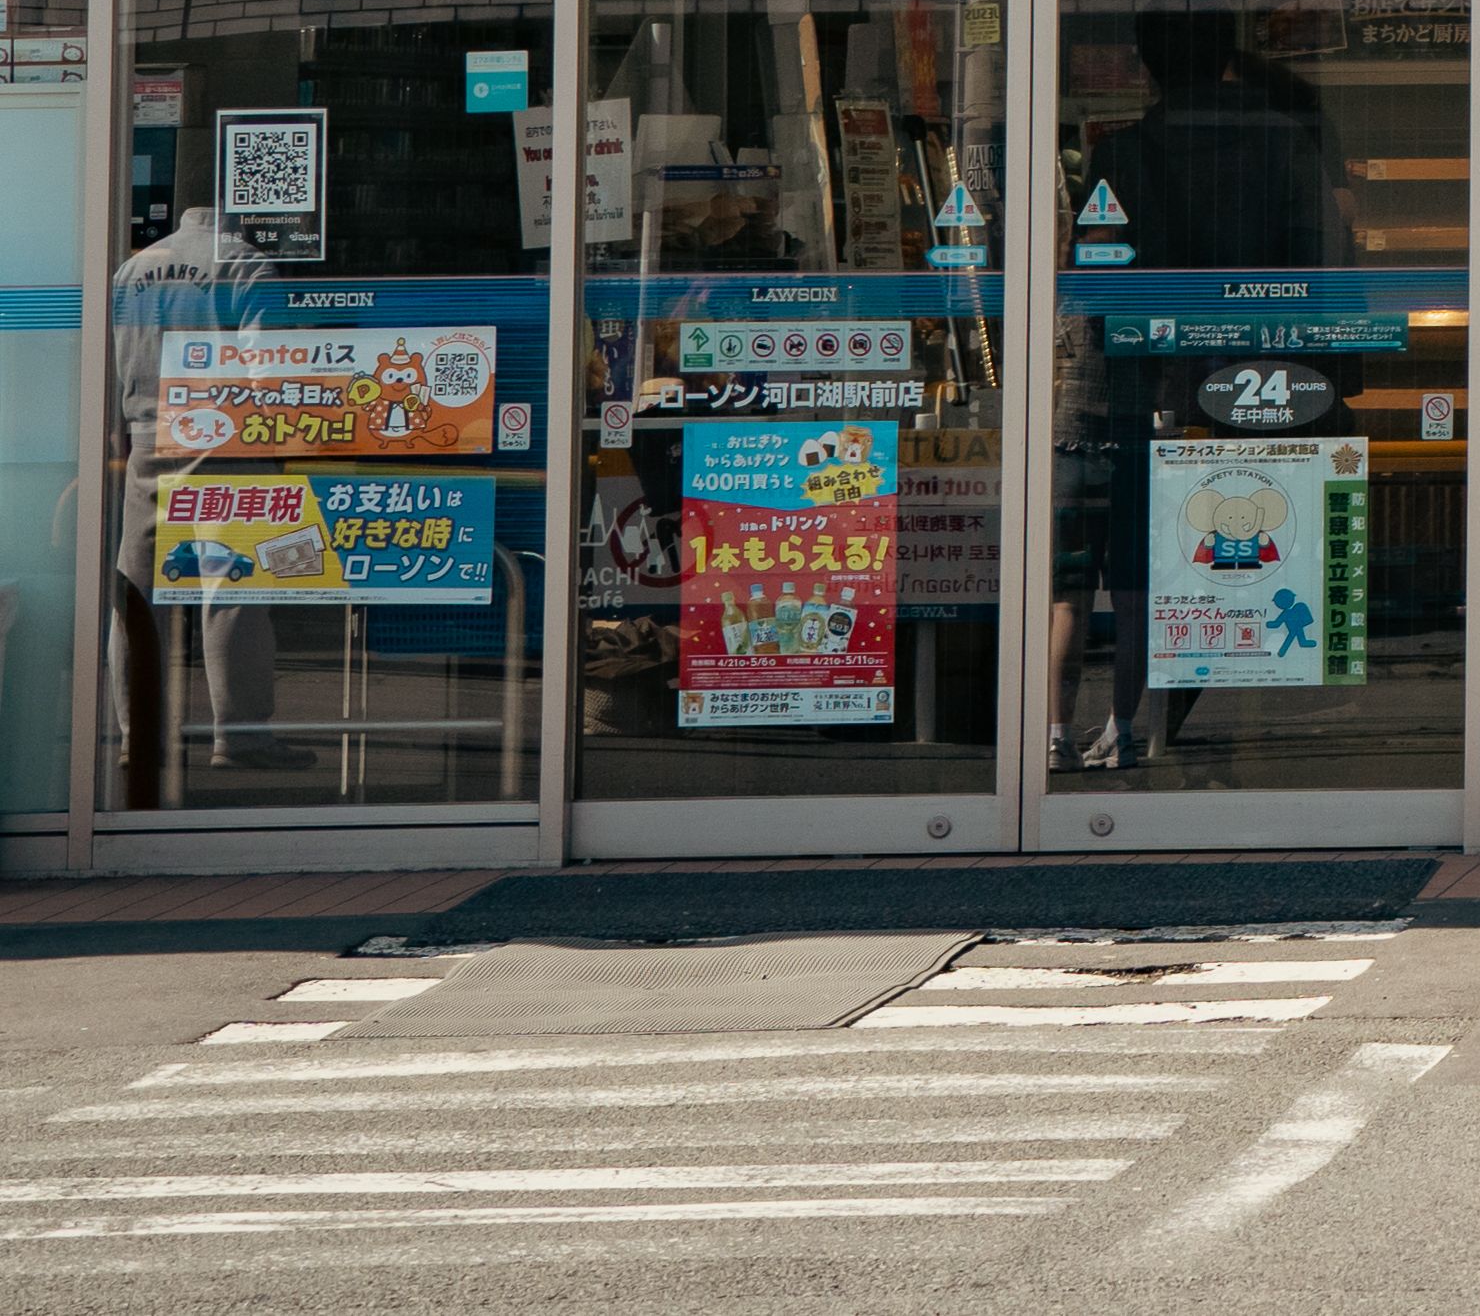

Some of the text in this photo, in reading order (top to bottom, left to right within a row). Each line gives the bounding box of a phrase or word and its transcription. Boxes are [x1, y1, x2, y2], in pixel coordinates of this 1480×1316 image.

[595, 138, 624, 155] drink
[240, 215, 301, 226] Information
[255, 231, 278, 243] 정보
[751, 288, 838, 302] LAWSON
[1224, 283, 1308, 297] LAWSON
[288, 292, 375, 308] LAWSON
[219, 343, 355, 366] Pontaパス
[661, 381, 923, 409] ローソン河口湖駅前店
[1206, 370, 1327, 405] OPEN 24 HOURS
[1231, 407, 1294, 423] 年中無休
[178, 416, 226, 442] もっと
[1156, 443, 1319, 457] セーフティステーション活動実施店
[705, 455, 789, 468] からあげクン
[692, 473, 795, 491] 400円買うと
[808, 465, 881, 492] 組み合わせ
[1201, 469, 1274, 488] SAFETY STATION
[326, 484, 463, 513] お支払いは
[834, 485, 862, 502] 自由
[167, 486, 305, 523] 自動車税
[771, 516, 828, 531] ドリンク
[333, 519, 474, 550] 好きな時に
[689, 534, 890, 573] 1本もらえる!
[1222, 541, 1253, 557] SS
[1328, 492, 1349, 676] 警察官立寄り店舗
[1351, 492, 1366, 675] 防犯カメラ設置店
[1167, 625, 1189, 637] 110
[1202, 625, 1223, 637] 119
[710, 704, 800, 714] からあげクン世界一
